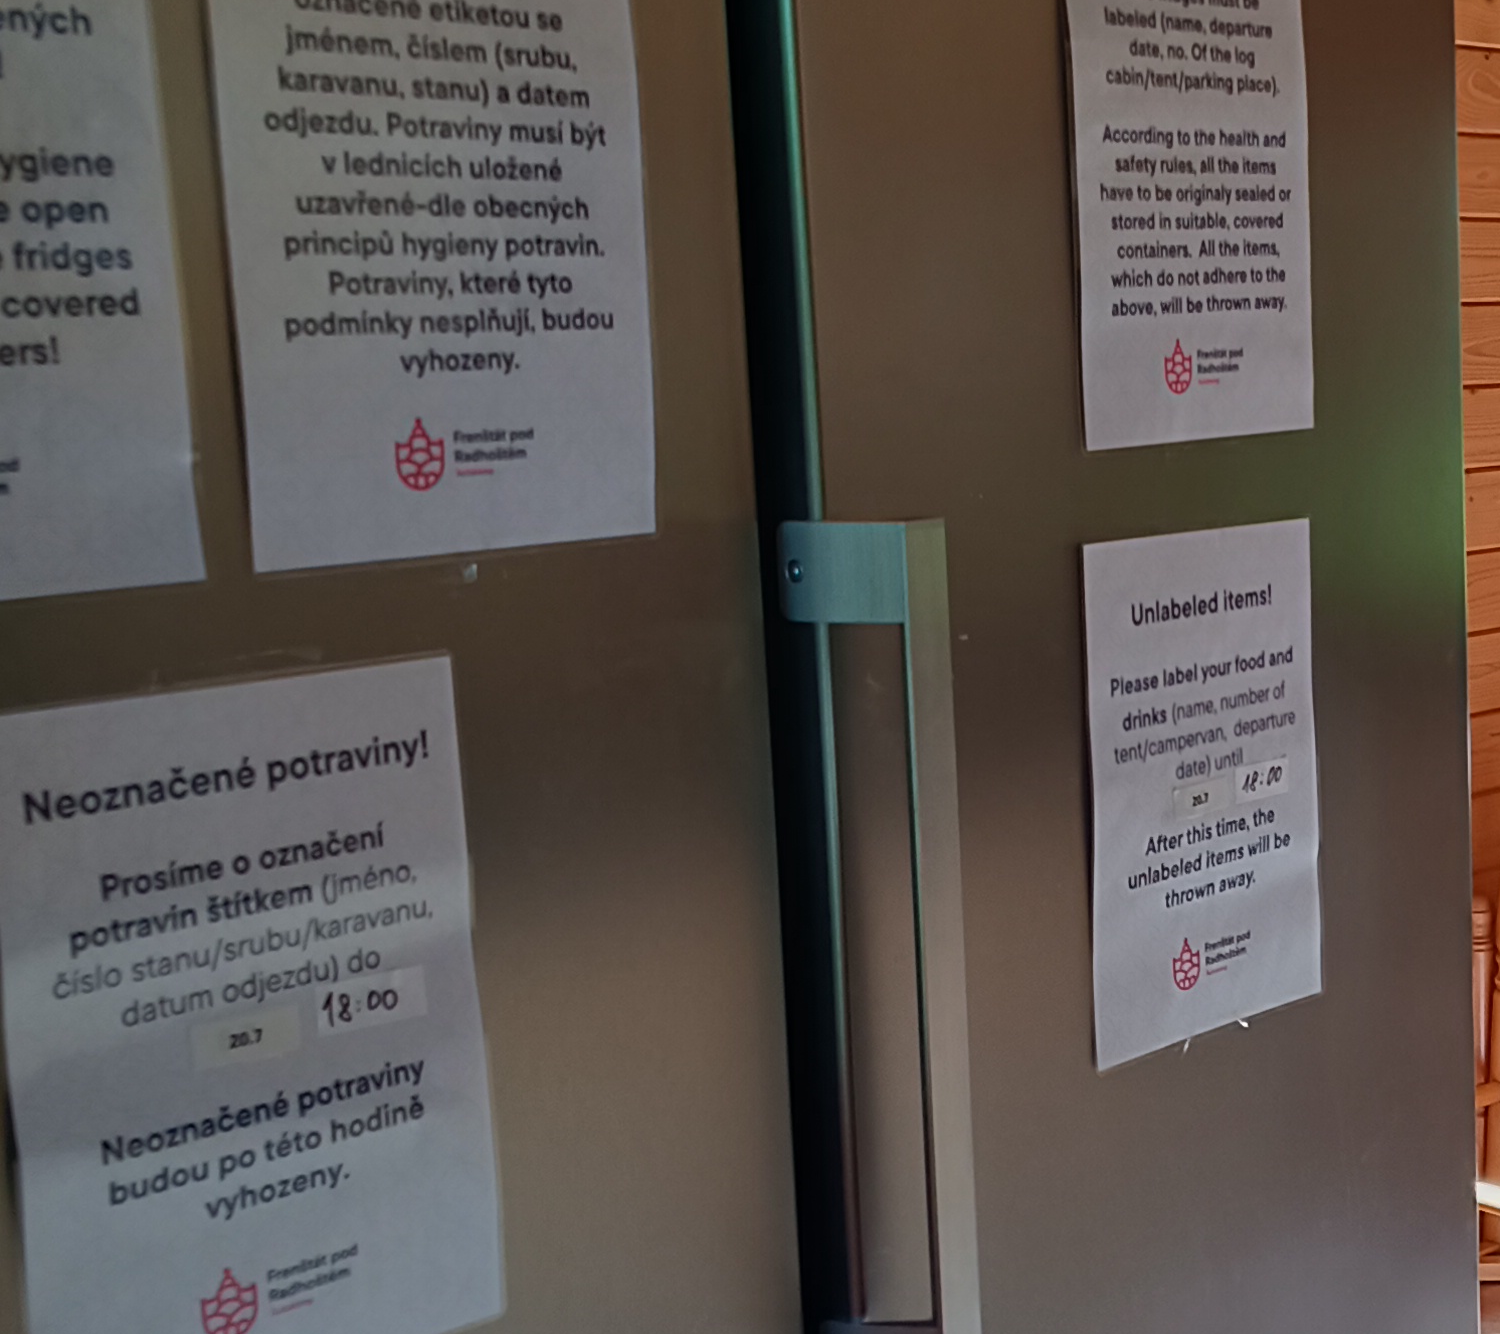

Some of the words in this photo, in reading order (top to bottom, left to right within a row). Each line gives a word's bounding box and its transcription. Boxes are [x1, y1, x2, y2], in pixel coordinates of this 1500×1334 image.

[429, 1, 529, 29] etiketou
[537, 11, 562, 32] se
[1104, 6, 1156, 29] labeled
[1161, 11, 1206, 34] (name,
[1210, 19, 1272, 39] departure
[286, 24, 400, 59] jménem,
[407, 34, 487, 64] číslem
[495, 42, 577, 72] (srubu,
[1130, 39, 1163, 61] date,
[1167, 45, 1187, 60] no.
[1191, 43, 1206, 61] Of
[1210, 46, 1231, 64] the
[1235, 49, 1255, 68] log
[278, 65, 405, 100] karavanu,
[413, 77, 489, 108] stanu)
[497, 86, 510, 103] a
[517, 84, 589, 109] datem
[264, 107, 378, 138] odjezdu.
[386, 113, 501, 146] Potraviny
[509, 121, 563, 145] musí
[571, 122, 606, 151] být
[1102, 124, 1173, 149] According
[1178, 129, 1190, 145] to
[1194, 129, 1215, 146] the
[1220, 129, 1259, 147] health
[1263, 131, 1286, 147] and
[322, 155, 336, 173] v
[344, 151, 462, 178] lednicích
[470, 156, 562, 181] uložené
[1115, 157, 1156, 177] safety
[1160, 156, 1196, 175] rules,
[1200, 157, 1214, 173] all
[1218, 157, 1238, 173] the
[1242, 158, 1276, 175] items
[1100, 183, 1133, 201] have
[1137, 185, 1150, 201] to
[1155, 185, 1172, 201] be
[1235, 185, 1274, 202] sealed
[1279, 189, 1291, 202] or
[21, 200, 108, 229] open
[473, 195, 589, 224] obecných
[1112, 214, 1154, 230] stored
[1160, 213, 1171, 229] in
[1175, 212, 1230, 231] suitable,
[1234, 213, 1283, 229] covered
[13, 241, 133, 277] fridges
[284, 230, 393, 260] principů
[402, 231, 498, 261] hygieny
[506, 234, 605, 259] potravin.
[1118, 241, 1192, 259] containers.
[1199, 239, 1215, 257] All
[1219, 239, 1238, 256] the
[1242, 239, 1280, 257] items,
[329, 271, 453, 299] Potraviny,
[460, 271, 520, 295] které
[528, 274, 572, 298] tyto
[1112, 269, 1152, 287] which
[1157, 269, 1174, 286] do
[1178, 269, 1200, 286] not
[1203, 267, 1246, 284] adhere
[1251, 267, 1262, 283] to
[1266, 265, 1285, 282] the
[1, 287, 141, 317] covered
[1112, 297, 1157, 317] above,
[1161, 297, 1182, 314] will
[1187, 297, 1202, 313] be
[1207, 295, 1250, 313] thrown
[1254, 295, 1286, 313] away.
[285, 311, 412, 342] podmínky
[420, 308, 535, 338] nesplňují,
[542, 308, 614, 331] budou
[401, 349, 519, 378] vyhozeny.
[1131, 591, 1218, 626] Unlabeled
[1223, 583, 1272, 611] items!
[1111, 676, 1158, 697] Please
[1163, 664, 1197, 687] label
[1202, 661, 1231, 684] your
[1235, 651, 1265, 673] food
[1269, 646, 1293, 666] and
[1123, 708, 1166, 731] drinks
[1172, 699, 1217, 725] (name,
[1220, 688, 1269, 711] number
[1273, 680, 1285, 699] of
[1234, 711, 1295, 737] departure
[22, 756, 256, 825] Neoznačené
[267, 729, 429, 791] potraviny!
[1176, 756, 1211, 779] date)
[1215, 747, 1243, 770] until
[1242, 766, 1282, 793] 18:00
[1145, 834, 1183, 856] After
[1187, 824, 1212, 845] this
[1216, 818, 1250, 838] time,
[1253, 808, 1275, 828] the
[100, 859, 224, 901] Prosíme
[232, 854, 250, 875] o
[260, 821, 384, 869] označení
[1128, 856, 1201, 890] unlabeled
[1206, 845, 1244, 868] items
[1248, 835, 1269, 856] will
[1274, 832, 1290, 848] be
[1165, 882, 1215, 908] thrown
[1219, 870, 1255, 892] away.
[69, 905, 198, 958] potravin
[207, 882, 312, 923] štítkem
[321, 863, 417, 905] (jméno,
[52, 965, 122, 1000] číslo
[121, 986, 214, 1028] datum
[222, 955, 339, 1003] odjezdu)
[347, 947, 380, 974] do
[322, 989, 397, 1028] 18:00
[101, 1092, 289, 1166] Neoznačené
[299, 1060, 424, 1117] potraviny
[109, 1161, 209, 1207] budou
[219, 1150, 256, 1180] po
[264, 1130, 322, 1161] této
[330, 1094, 425, 1144] hodině
[206, 1163, 350, 1220] vyhozeny.
